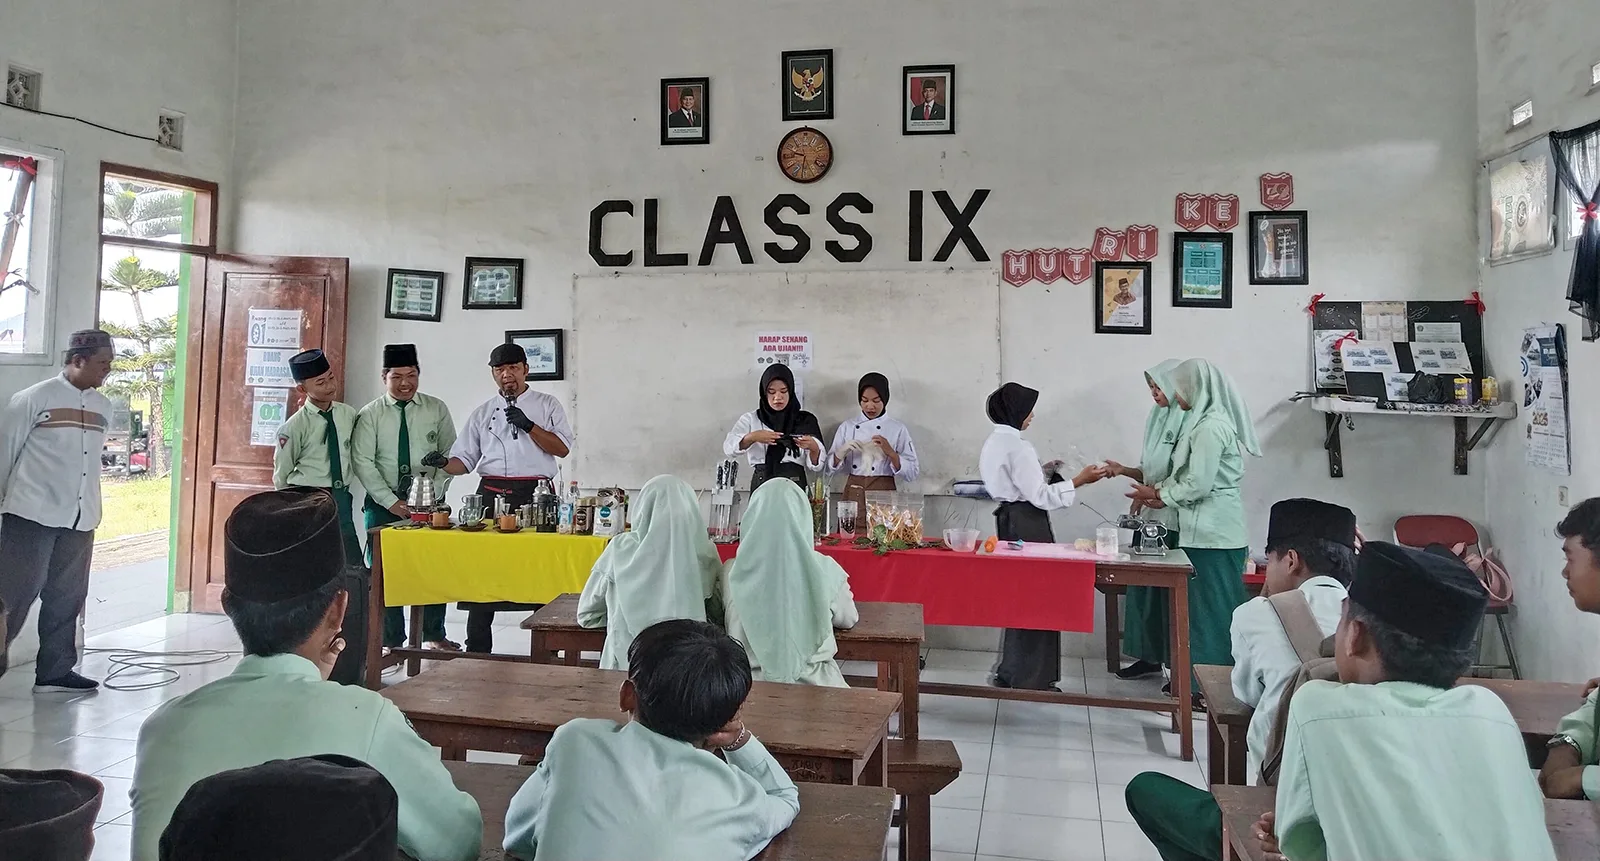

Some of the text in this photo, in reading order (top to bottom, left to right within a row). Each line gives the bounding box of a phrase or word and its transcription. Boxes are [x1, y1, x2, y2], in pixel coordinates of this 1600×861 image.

[588, 189, 991, 267] CLASS IX
[1009, 253, 1086, 276] HUT
[1101, 231, 1148, 257] RI
[1183, 200, 1232, 221] KE
[758, 335, 781, 343] HARAP
